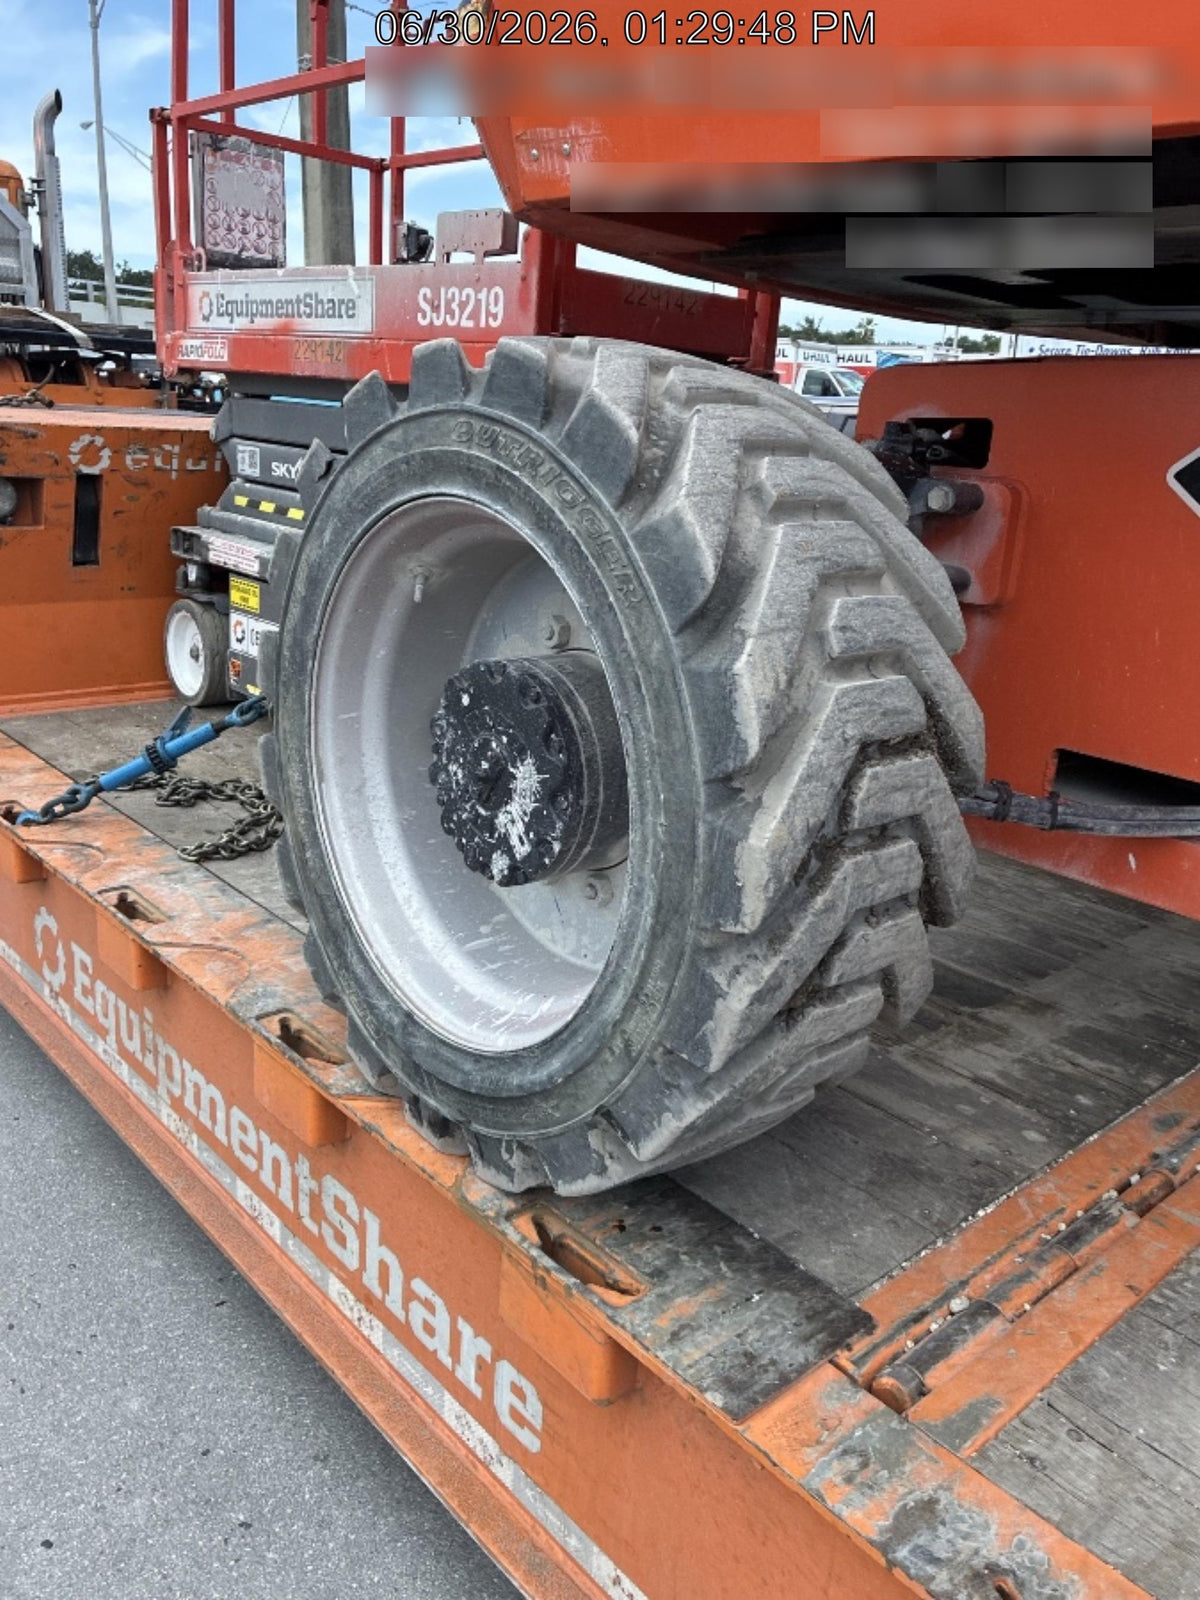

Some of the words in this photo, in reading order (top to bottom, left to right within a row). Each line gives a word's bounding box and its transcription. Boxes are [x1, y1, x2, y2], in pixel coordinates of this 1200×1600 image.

[216, 291, 356, 323] EquipmentShare
[417, 286, 504, 328] SJ3219
[452, 419, 645, 607] OUTRIGGER
[71, 940, 544, 1454] EquipmentShare
